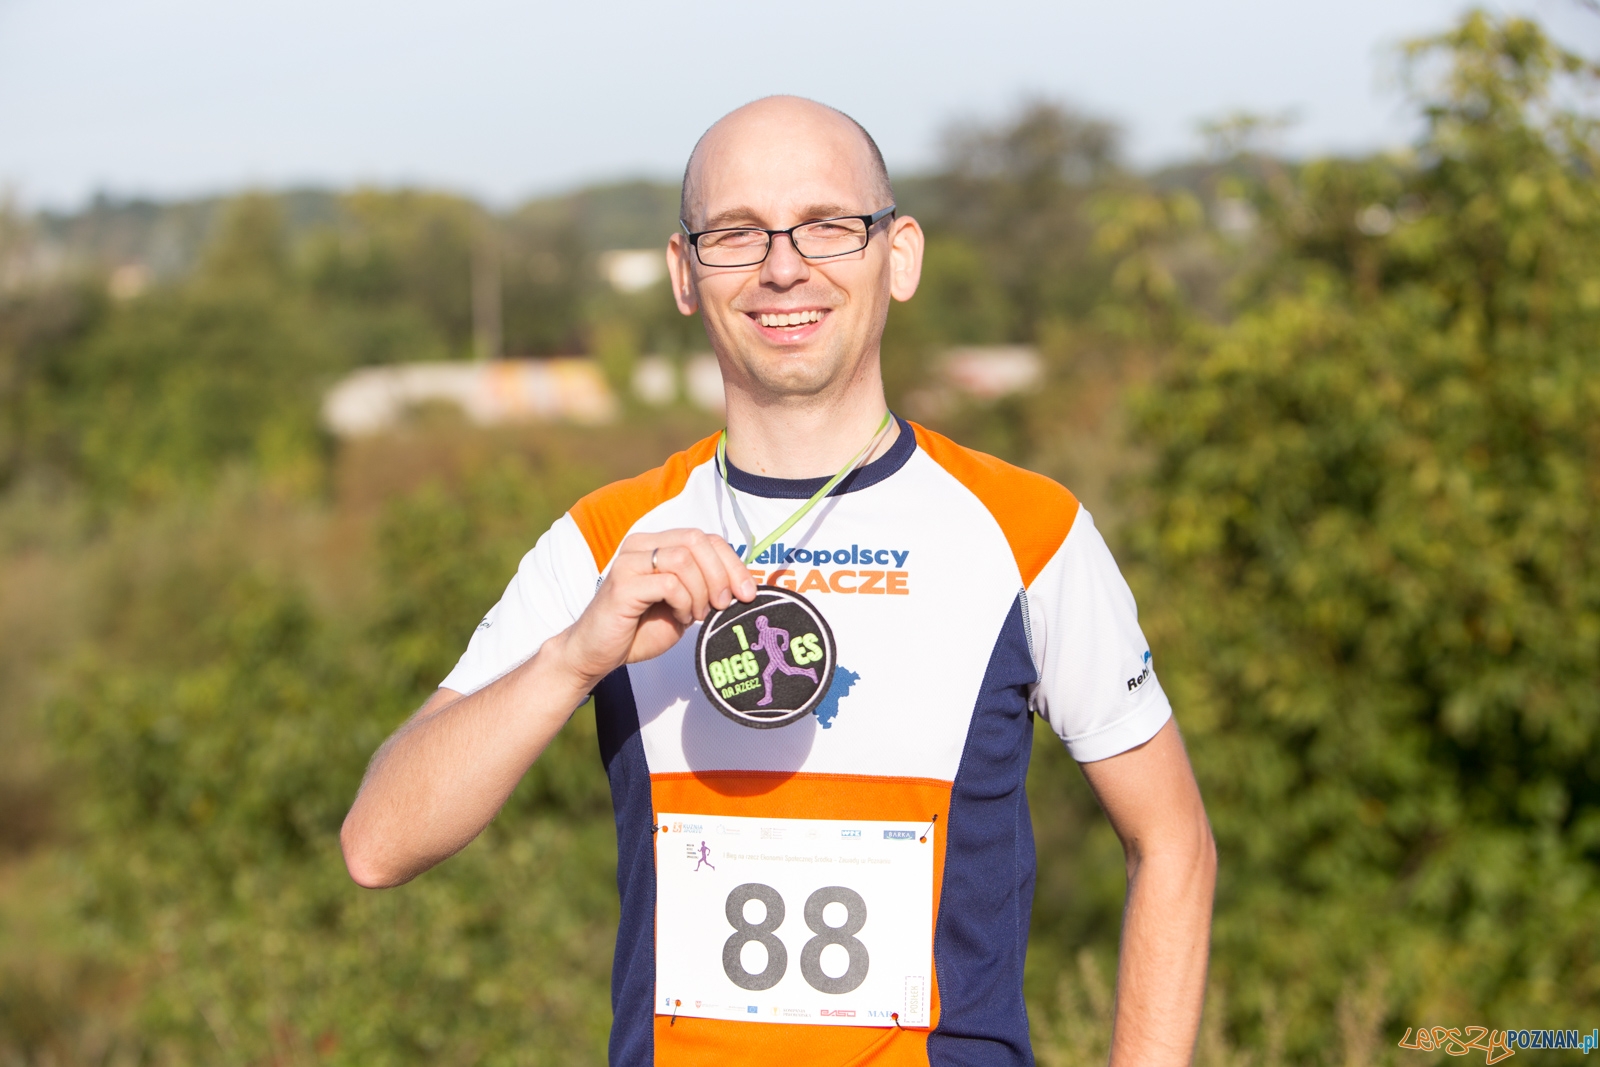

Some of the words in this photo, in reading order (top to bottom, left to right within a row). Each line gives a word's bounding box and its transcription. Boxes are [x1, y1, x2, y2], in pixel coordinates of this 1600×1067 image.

[727, 543, 910, 568] elkopolscy
[789, 632, 824, 666] ES
[708, 650, 759, 689] BIEG
[722, 882, 870, 994] 88
